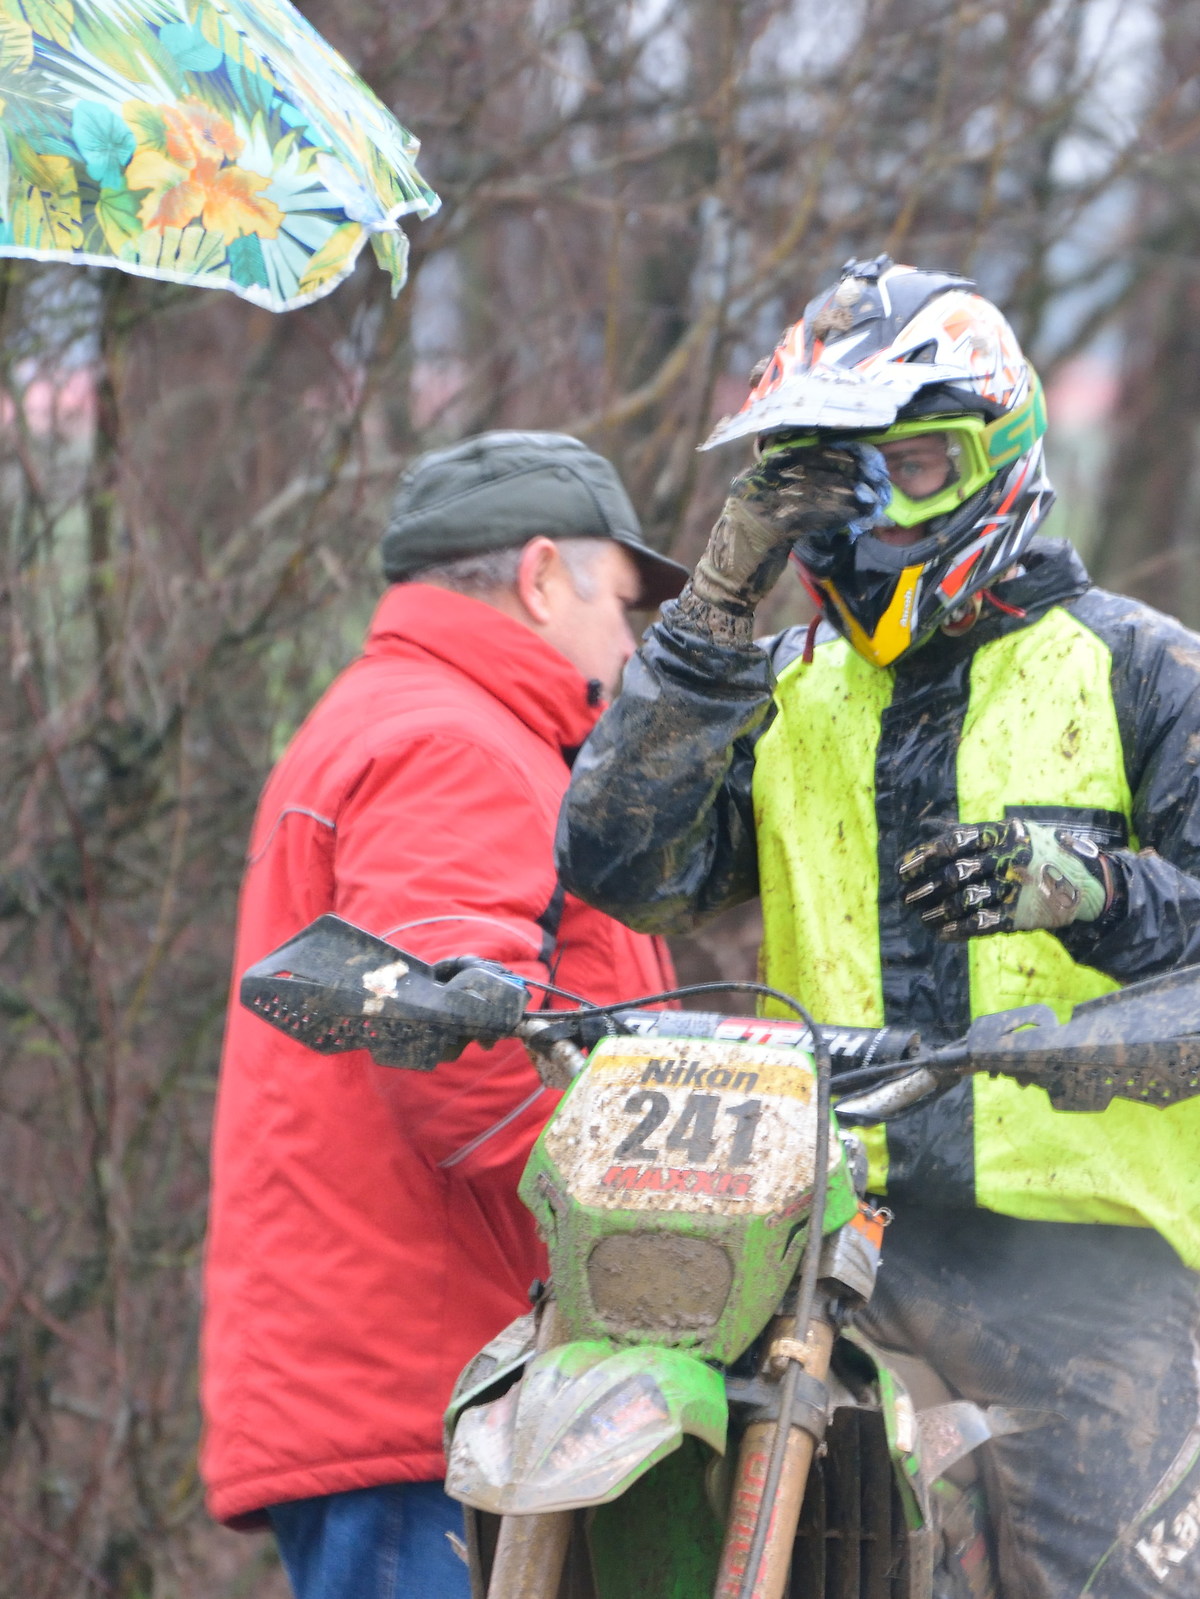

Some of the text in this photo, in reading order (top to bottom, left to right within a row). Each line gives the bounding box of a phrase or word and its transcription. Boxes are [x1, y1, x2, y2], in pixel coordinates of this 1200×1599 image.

[641, 1058, 760, 1093] Nikon
[614, 1090, 763, 1168] 241
[601, 1166, 752, 1197] MAXXIS
